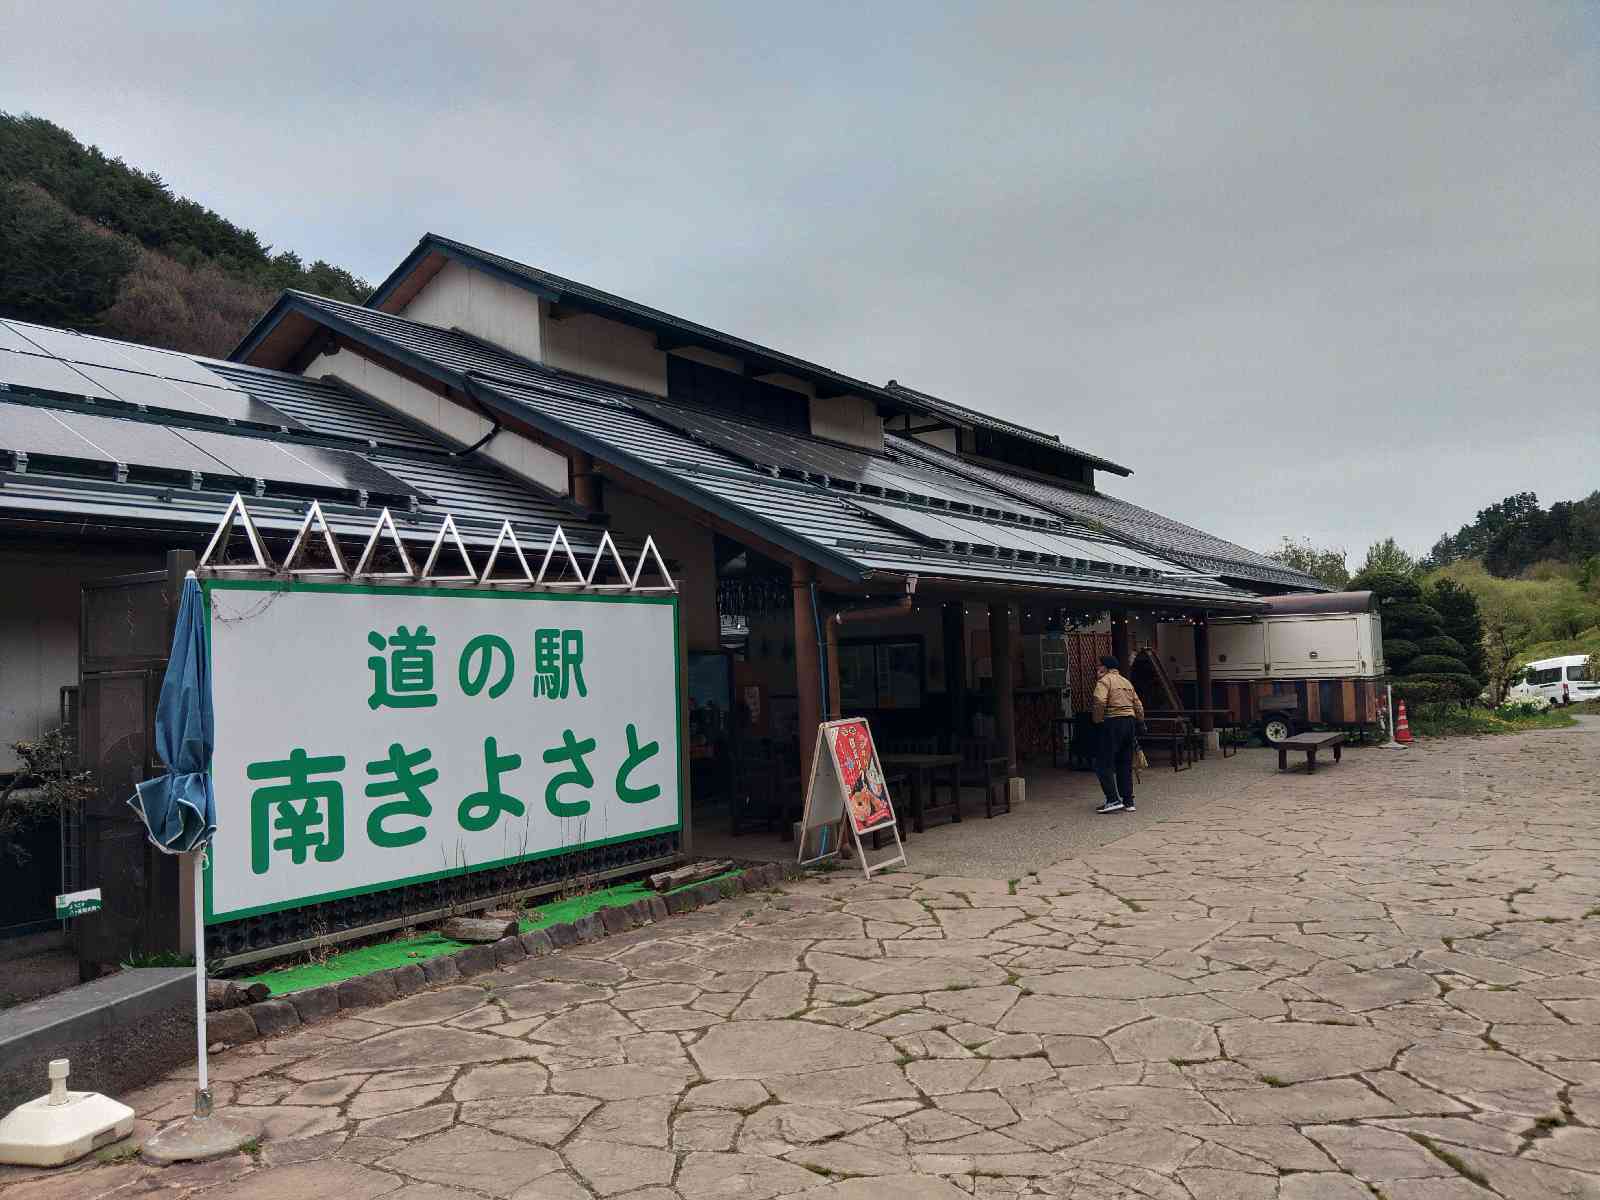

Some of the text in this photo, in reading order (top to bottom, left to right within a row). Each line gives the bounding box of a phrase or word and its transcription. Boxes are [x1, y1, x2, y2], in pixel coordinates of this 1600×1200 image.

[368, 624, 588, 710] 道の駅
[246, 723, 662, 876] 南きよさと
